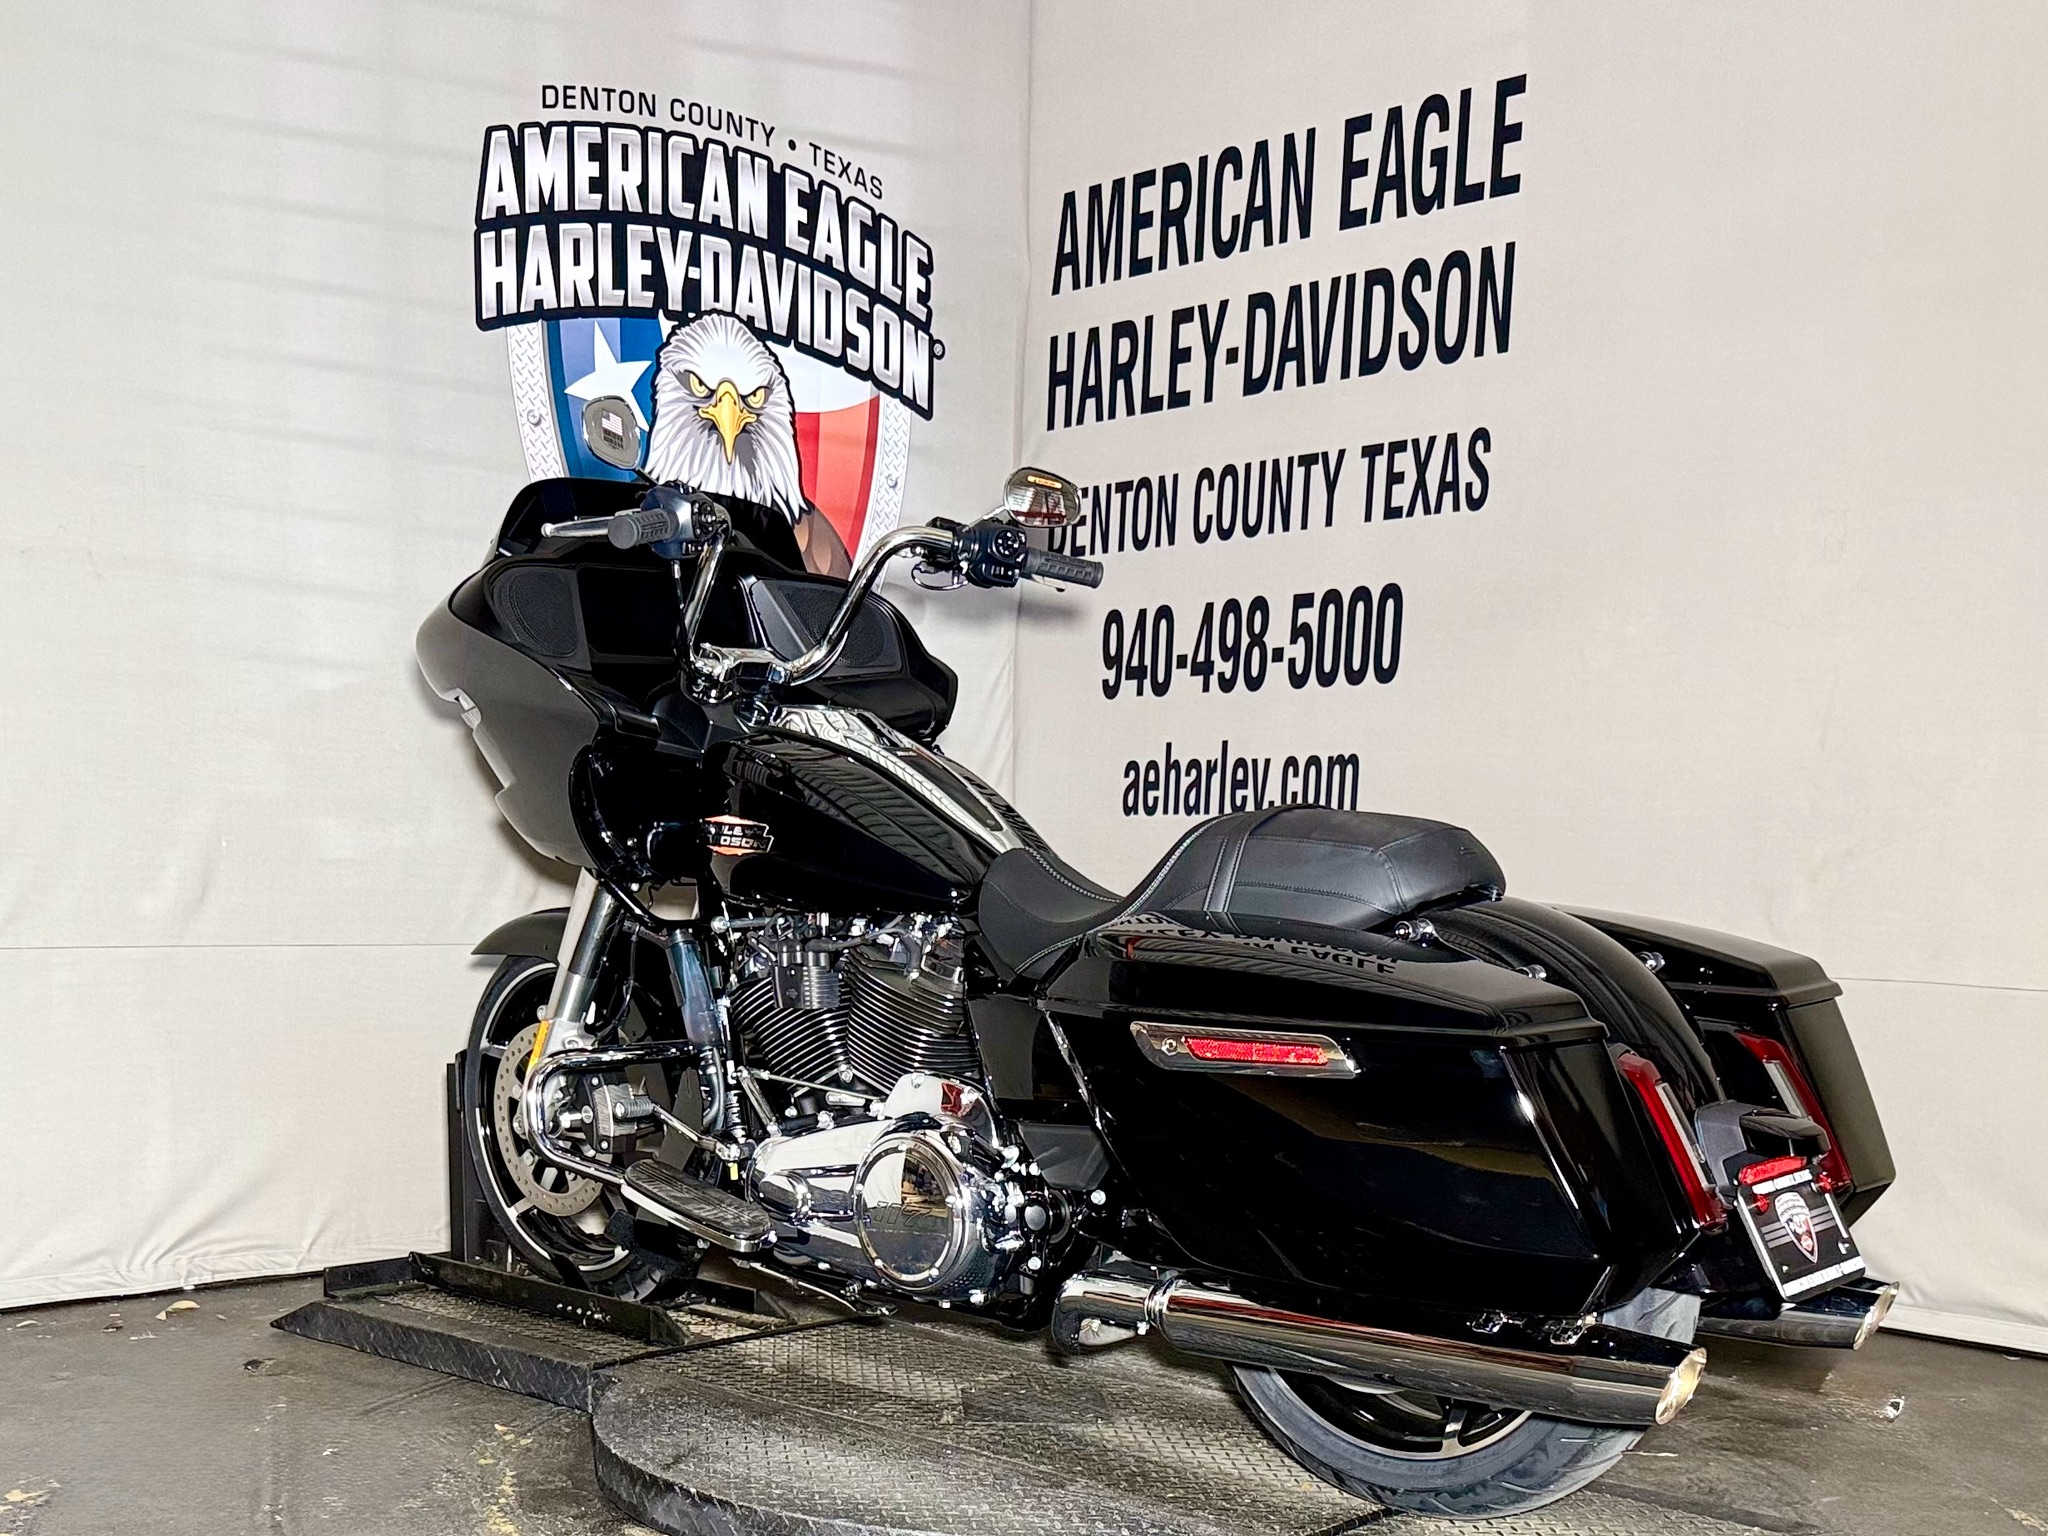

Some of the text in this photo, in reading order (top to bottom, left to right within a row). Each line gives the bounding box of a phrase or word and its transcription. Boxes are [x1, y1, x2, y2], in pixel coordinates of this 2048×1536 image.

[541, 84, 884, 199] DENTON COUNTY TEXAS
[1050, 73, 1528, 296] AMERICAN EAGLE
[479, 123, 931, 320] AMERICAN EAGLE
[478, 220, 932, 413] HARLEY-DAVIDSON
[1046, 241, 1516, 431] HARLEY-DAVIDSON
[1192, 448, 1346, 544] COUNTY
[1360, 427, 1492, 523] TEXAS
[1101, 582, 1403, 700] 940-498-5000
[1122, 740, 1360, 817] aeharley.com
